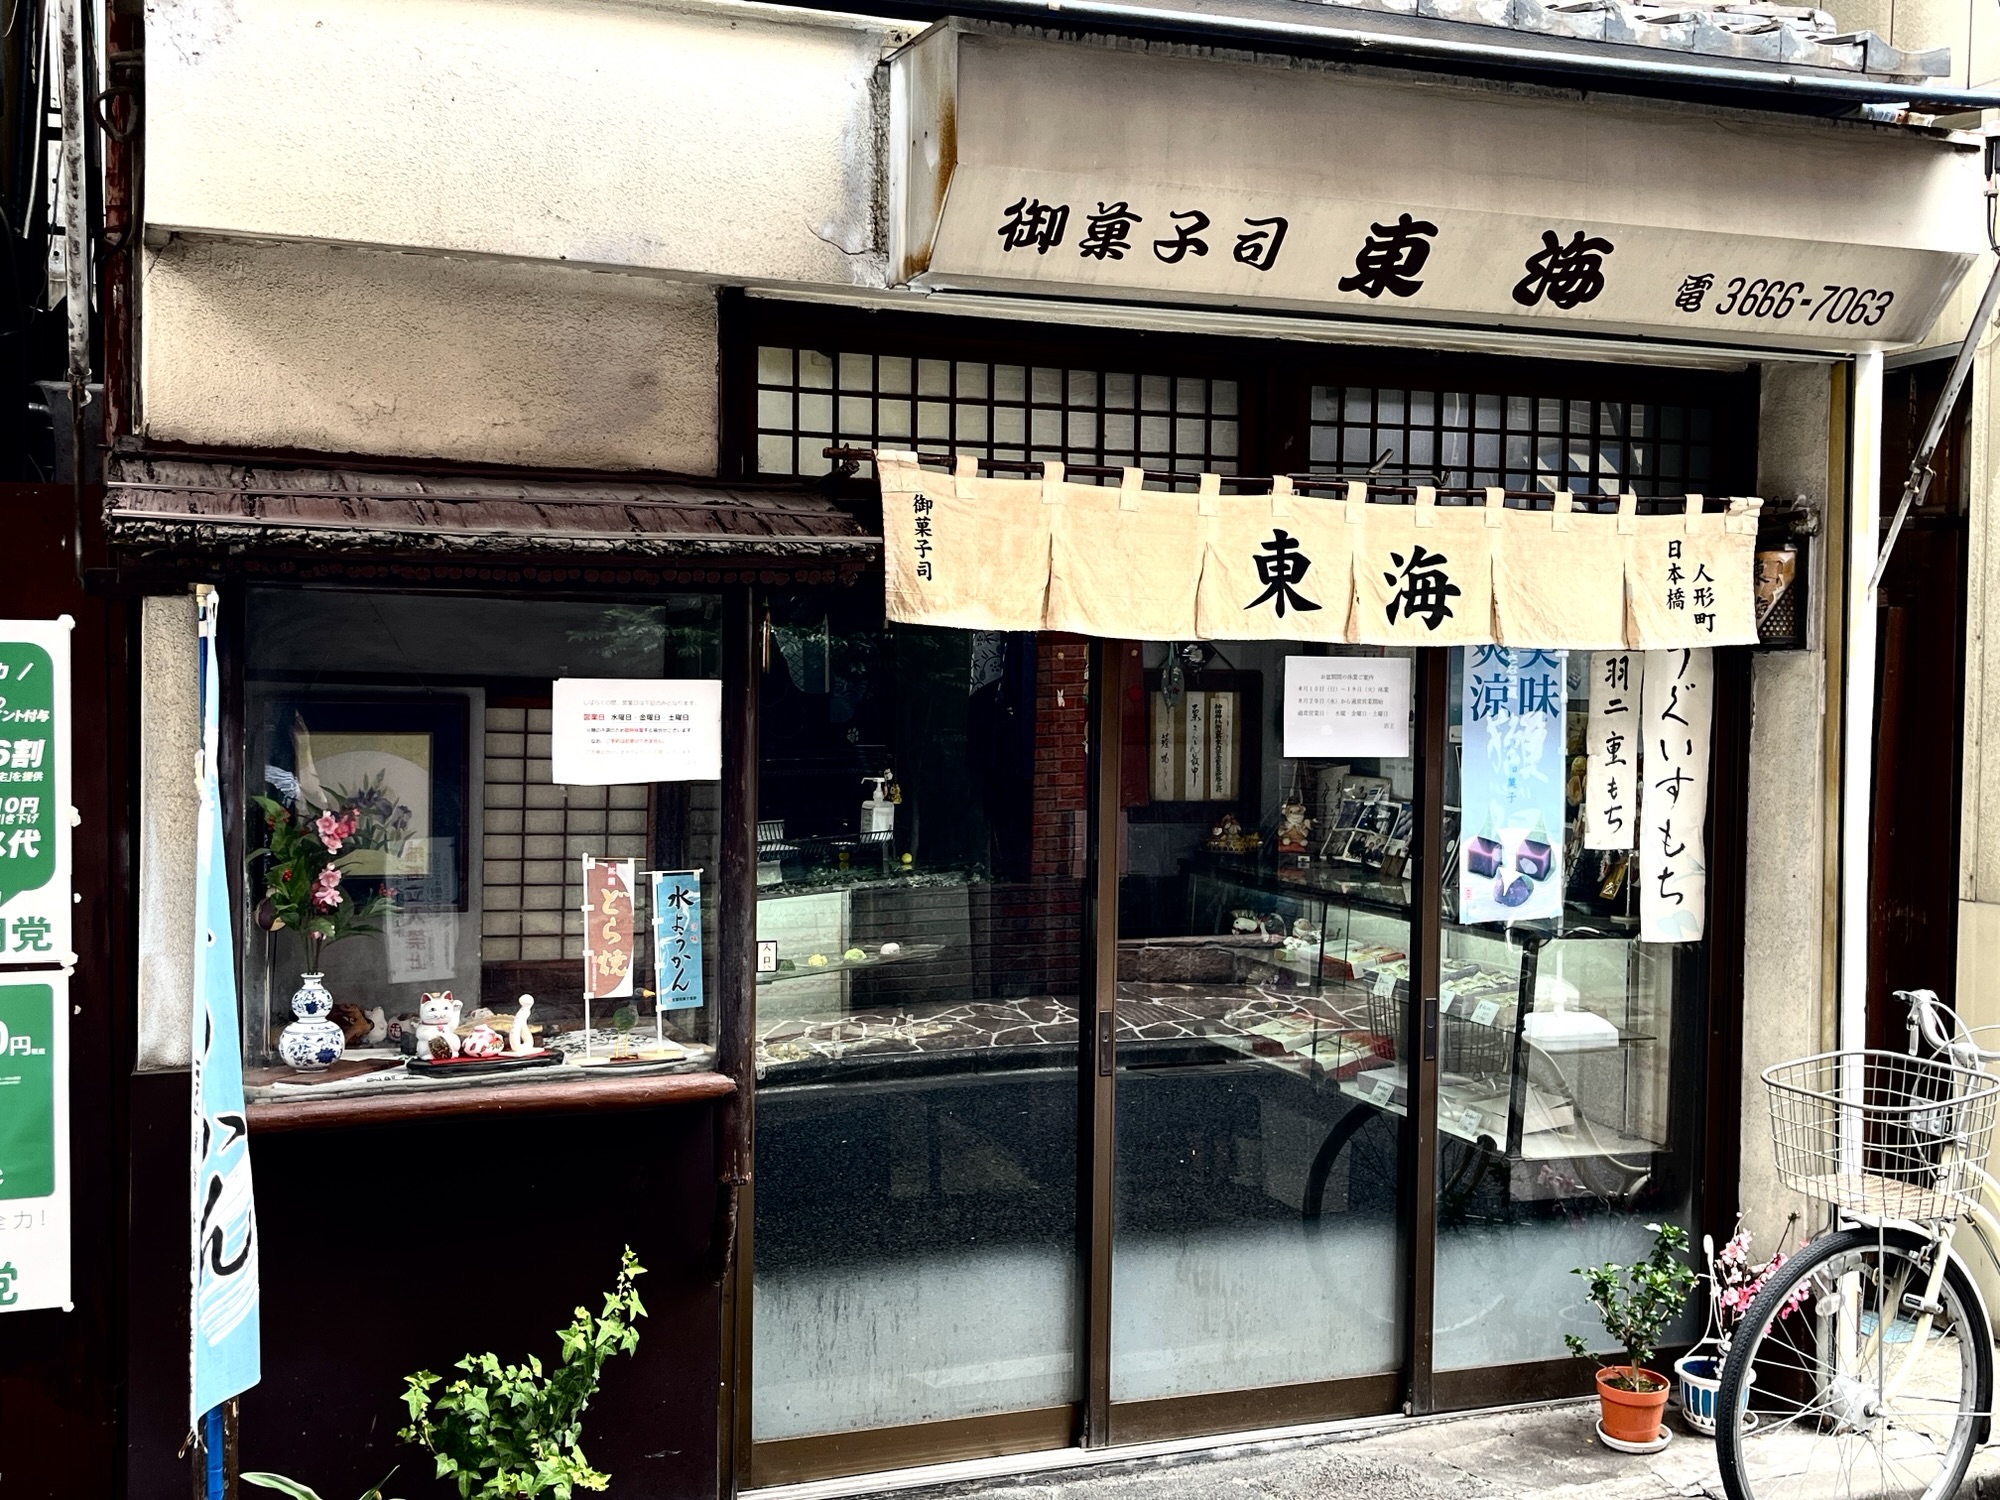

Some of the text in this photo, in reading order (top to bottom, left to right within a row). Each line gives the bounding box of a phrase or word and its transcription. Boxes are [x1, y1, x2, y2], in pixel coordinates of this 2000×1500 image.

[998, 197, 1289, 272] 御菓子司
[1338, 213, 1615, 310] 東海
[913, 493, 933, 582] 御菓子司
[1243, 528, 1462, 631] 東海
[1666, 540, 1686, 611] 日本橋
[1692, 563, 1717, 633] 人形町
[1603, 655, 1630, 834] 羽二重もち
[0, 916, 53, 953] 党
[597, 888, 630, 976] どら焼
[667, 885, 695, 992] 水ようかん
